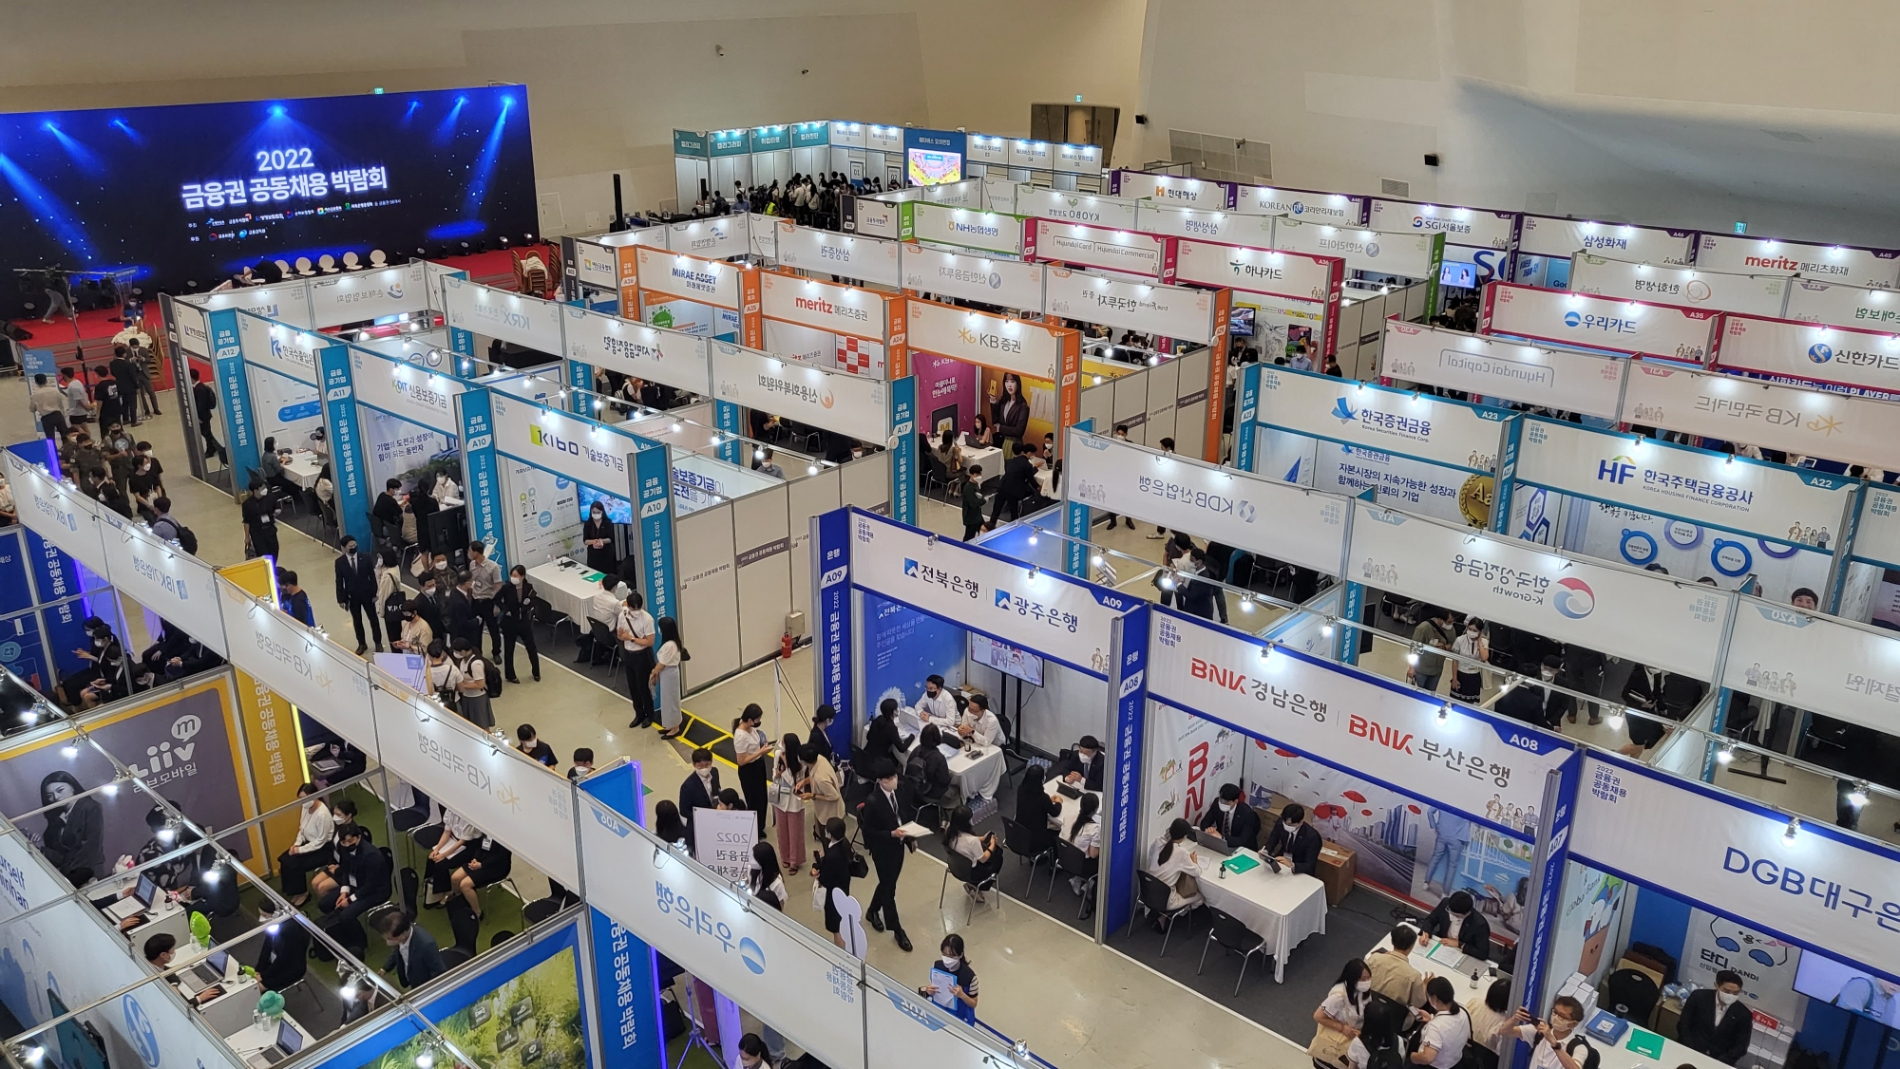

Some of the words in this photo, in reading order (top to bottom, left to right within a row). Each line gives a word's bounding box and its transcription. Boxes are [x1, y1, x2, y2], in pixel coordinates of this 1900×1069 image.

[256, 148, 314, 172] 2022
[853, 168, 860, 176] 01
[182, 179, 248, 210] 금융권
[250, 172, 328, 203] 공동채용
[331, 166, 388, 193] 박람회
[1168, 189, 1198, 201] 현대해상
[1259, 200, 1292, 212] KOREAN
[1304, 205, 1345, 217] 코리안리재보험
[956, 222, 998, 236] NH농협생명
[1425, 220, 1471, 234] SGI서울보증
[1583, 234, 1627, 251] 삼성화재
[1097, 246, 1120, 255] Hyundai
[1120, 249, 1155, 260] Commercial
[1245, 266, 1283, 280] 하나카드
[1745, 253, 1798, 272] meritz
[1800, 261, 1849, 277] 메리츠화재
[672, 268, 695, 279] MIRAE
[696, 273, 717, 285] ASSET
[686, 280, 716, 294] 미래에셋증권
[795, 296, 833, 314] meritz
[834, 304, 868, 322] 메리츠증권
[1690, 311, 1704, 319] A35
[722, 313, 738, 323] MIRAE
[1582, 314, 1637, 335] 우리카드
[217, 336, 235, 345] 공기업
[980, 332, 1021, 353] KB증권
[222, 349, 236, 357] A12
[1835, 349, 1899, 370] 신한카드
[328, 376, 346, 386] 공기업
[330, 369, 342, 377] 금융
[333, 389, 345, 398] A11
[408, 384, 447, 408] 신용보증기금
[232, 398, 244, 425] 공동채용
[897, 403, 907, 411] 금융
[1482, 411, 1498, 420] A23
[470, 416, 483, 425] 금융
[895, 411, 910, 421] 공기업
[1361, 408, 1432, 436] 한국증권금융
[468, 423, 487, 434] 공기업
[897, 425, 908, 434] A17
[1362, 424, 1375, 433] Korea
[1376, 427, 1398, 437] Securities
[1399, 432, 1417, 440] Finance
[376, 440, 395, 452] 기업의
[396, 437, 415, 447] 도전과
[416, 432, 435, 443] 성장에
[472, 439, 486, 448] A10
[343, 443, 354, 472] 공동채용
[378, 451, 391, 462] 힘이
[392, 449, 405, 459] 되는
[406, 444, 425, 455] 동반자
[582, 445, 624, 472] 기술보증기금
[1339, 463, 1381, 481] 자본시장의
[1383, 474, 1427, 490] 지속가능한
[1429, 484, 1457, 498] 성장과
[1598, 459, 1637, 485] HF
[478, 471, 489, 497] 금융권
[645, 477, 658, 488] 금융
[1338, 475, 1374, 492] 함께하는
[1403, 490, 1419, 503] 기업
[1644, 468, 1754, 505] 한국주택금융공사
[1810, 477, 1832, 488] A22
[643, 486, 663, 498] 공기업
[1642, 485, 1660, 495] KOREA
[1661, 489, 1685, 500] HOUSING
[1686, 493, 1709, 505] FINANCE
[1710, 499, 1750, 512] CORPORATION
[1873, 496, 1893, 505] 금융권
[481, 497, 493, 530] 공동채용
[647, 502, 661, 514] A10
[1870, 508, 1890, 517] 박람회
[1872, 502, 1898, 512] 공동채용
[652, 539, 662, 568] 금융권
[827, 548, 841, 561] 은행
[48, 559, 66, 595] 공동채용
[826, 570, 842, 584] A09
[920, 564, 979, 599] 전북은행
[654, 568, 666, 605] 공동채용
[1102, 595, 1123, 609] A09
[1014, 595, 1079, 633] 광주은행
[830, 611, 840, 643] 금융권
[1160, 621, 1177, 633] 금융권
[1158, 630, 1182, 643] 공동채용
[1158, 636, 1176, 648] 박람회
[830, 643, 841, 684] 공동채용
[1123, 676, 1139, 694] A08
[1190, 657, 1247, 695] BNK
[1251, 678, 1328, 723] 경남은행
[260, 708, 279, 752] 공동채용
[270, 752, 286, 786] 박람회
[1123, 724, 1133, 761] 금융권
[1509, 733, 1539, 751] A08
[1348, 714, 1414, 756] BNK
[1418, 738, 1512, 789] 부산은행
[1596, 764, 1614, 774] 2022
[132, 762, 198, 794] 리브모바일
[1121, 760, 1131, 807] 공동채용
[1594, 770, 1621, 786] 금융권
[1591, 788, 1618, 804] 박람회
[1592, 779, 1628, 798] 공동채용
[1118, 807, 1128, 844] 박람회
[1701, 948, 1729, 969] 단디
[613, 953, 634, 1004] 공동채용
[1730, 966, 1759, 982] DANDI
[619, 1005, 637, 1050] 박람회
